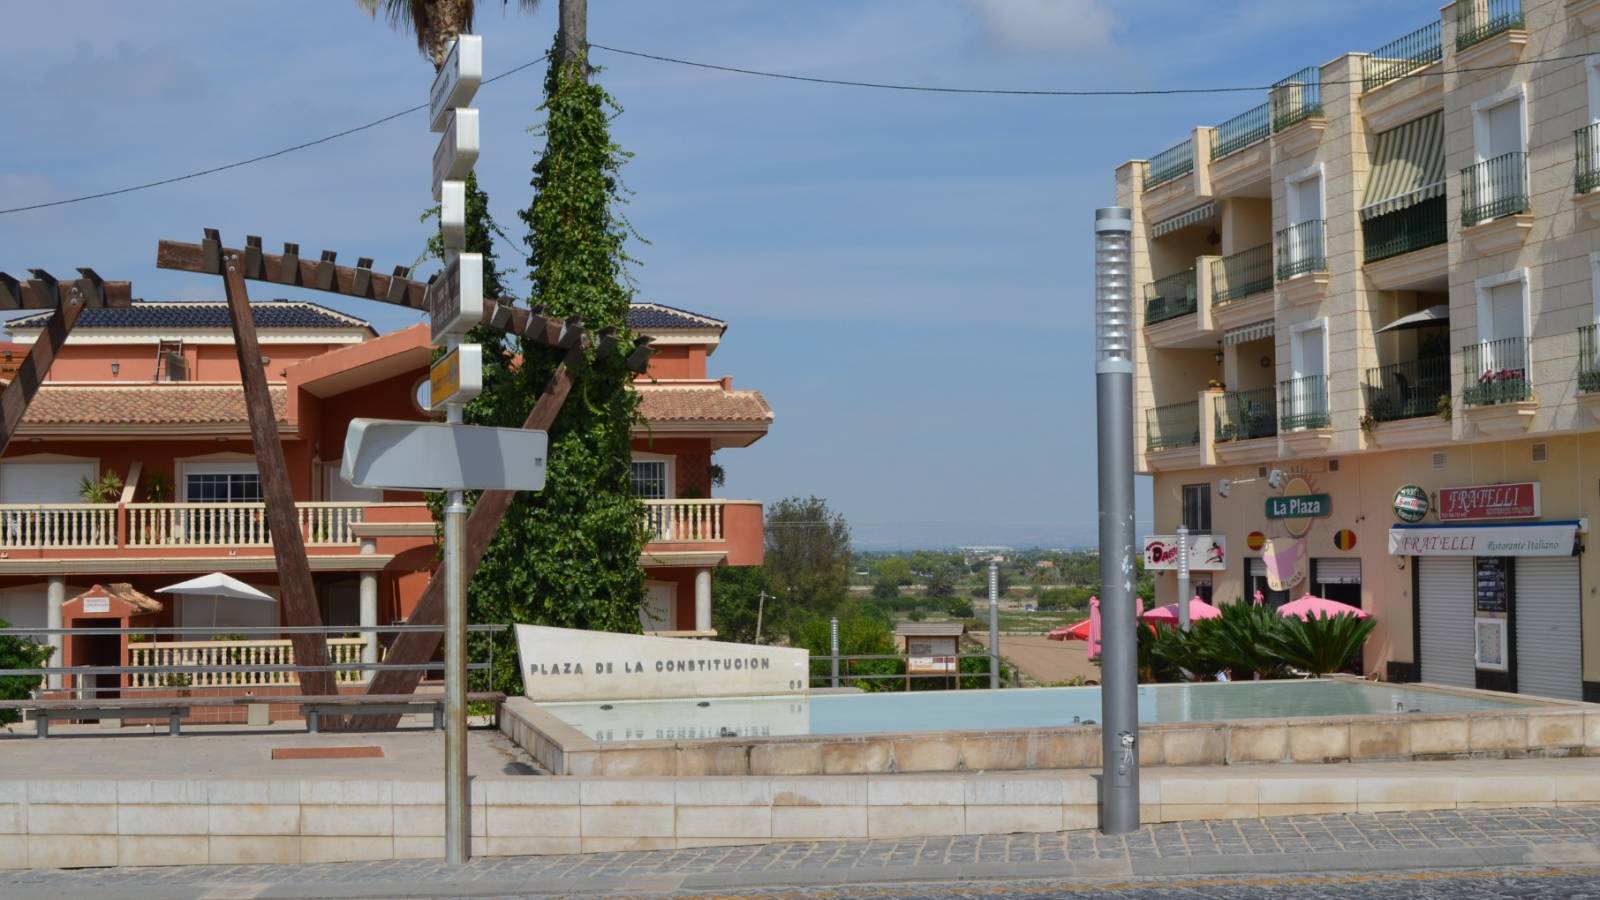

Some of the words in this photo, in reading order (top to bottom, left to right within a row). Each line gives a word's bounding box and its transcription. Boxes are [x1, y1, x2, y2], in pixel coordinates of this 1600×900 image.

[1273, 500, 1287, 516] La
[1290, 498, 1320, 514] Plaza
[1449, 487, 1519, 513] FRATELLI
[1401, 535, 1476, 553] FRATELLI
[1527, 539, 1559, 551] Italiano
[530, 662, 583, 676] PLAZA
[595, 662, 614, 674] DE
[625, 661, 645, 674] LA
[655, 657, 770, 673] CONSTITUCION
